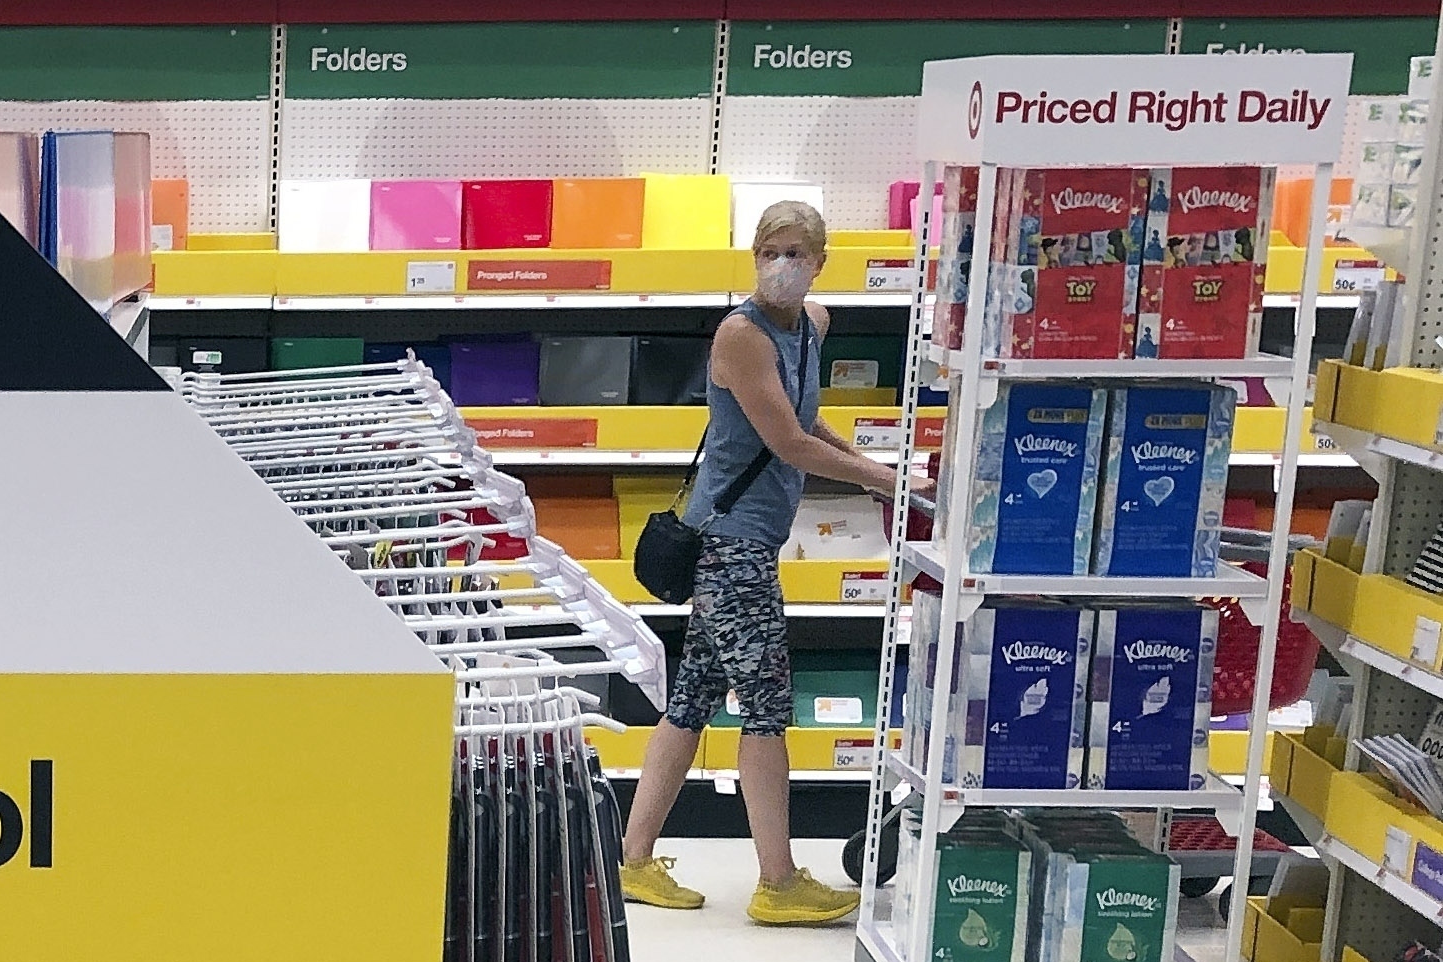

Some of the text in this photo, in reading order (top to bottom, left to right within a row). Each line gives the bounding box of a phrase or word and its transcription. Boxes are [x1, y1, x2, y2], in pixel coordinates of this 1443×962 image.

[310, 47, 407, 72] Folders
[753, 44, 853, 68] Folders
[995, 89, 1332, 132] Priced Right Daily
[1050, 186, 1124, 214] Kleenex
[1177, 185, 1252, 214] Kleenex
[1065, 280, 1097, 297] TOY
[1192, 280, 1224, 297] TOY
[1014, 433, 1078, 458] Kleenex
[1131, 441, 1197, 464] Kleenex
[1004, 493, 1014, 505] 4
[1121, 500, 1131, 512] 4
[1002, 640, 1068, 665] Kleenex
[1124, 640, 1191, 664] Kleenex
[990, 721, 1000, 734] 4
[1112, 720, 1122, 733] 4
[947, 875, 1008, 898] Kleenex
[1096, 888, 1159, 911] Kleenex
[935, 947, 945, 959] 4
